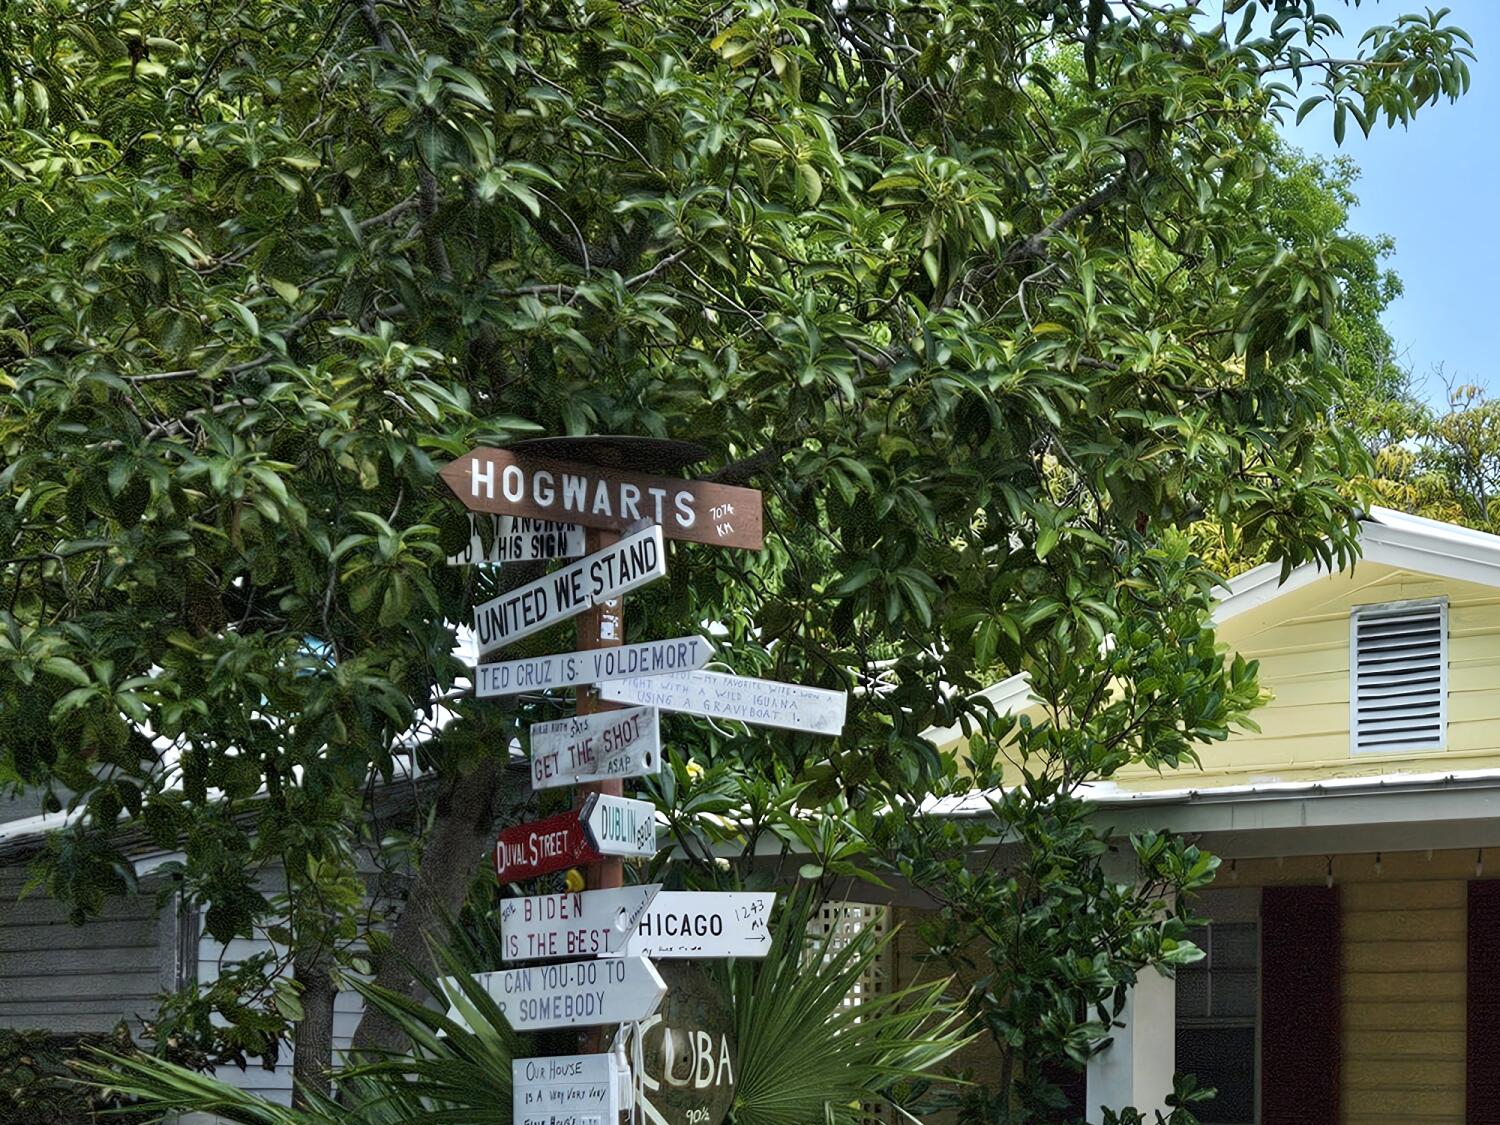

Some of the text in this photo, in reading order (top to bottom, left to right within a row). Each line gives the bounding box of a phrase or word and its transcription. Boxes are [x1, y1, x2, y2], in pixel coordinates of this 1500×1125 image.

[471, 458, 696, 528] HOGWARTS
[716, 522, 735, 537] KM
[484, 535, 523, 560] HIS
[531, 532, 568, 558] SIGN
[477, 537, 656, 645] UNITED WE STAND
[480, 666, 509, 690] TED
[516, 660, 553, 686] CRUZ
[593, 640, 700, 679] VOLDEMORT
[637, 690, 673, 705] USING
[683, 698, 691, 708] A
[703, 699, 780, 721] GRAVYBOAT
[698, 687, 706, 697] A
[715, 689, 743, 701] WILD
[753, 695, 799, 710] IGUANA
[534, 713, 640, 781] GET THE SHOT
[607, 756, 631, 774] ASAP
[601, 805, 636, 844] DUBLIN
[496, 840, 528, 874] DUVAL
[529, 830, 569, 866] STREET
[524, 894, 583, 922] BIDEN
[734, 899, 765, 922] 1243
[638, 913, 723, 937] HICAGO
[505, 934, 519, 958] IS
[527, 932, 557, 956] THE
[504, 968, 532, 994] CAN
[540, 965, 568, 989] YOU
[577, 962, 597, 986] DO
[605, 960, 625, 984] TO
[519, 991, 605, 1022] SOMEBODY
[632, 1013, 734, 1090] CUBA
[549, 1059, 583, 1080] HOUSE
[536, 1089, 543, 1103] A
